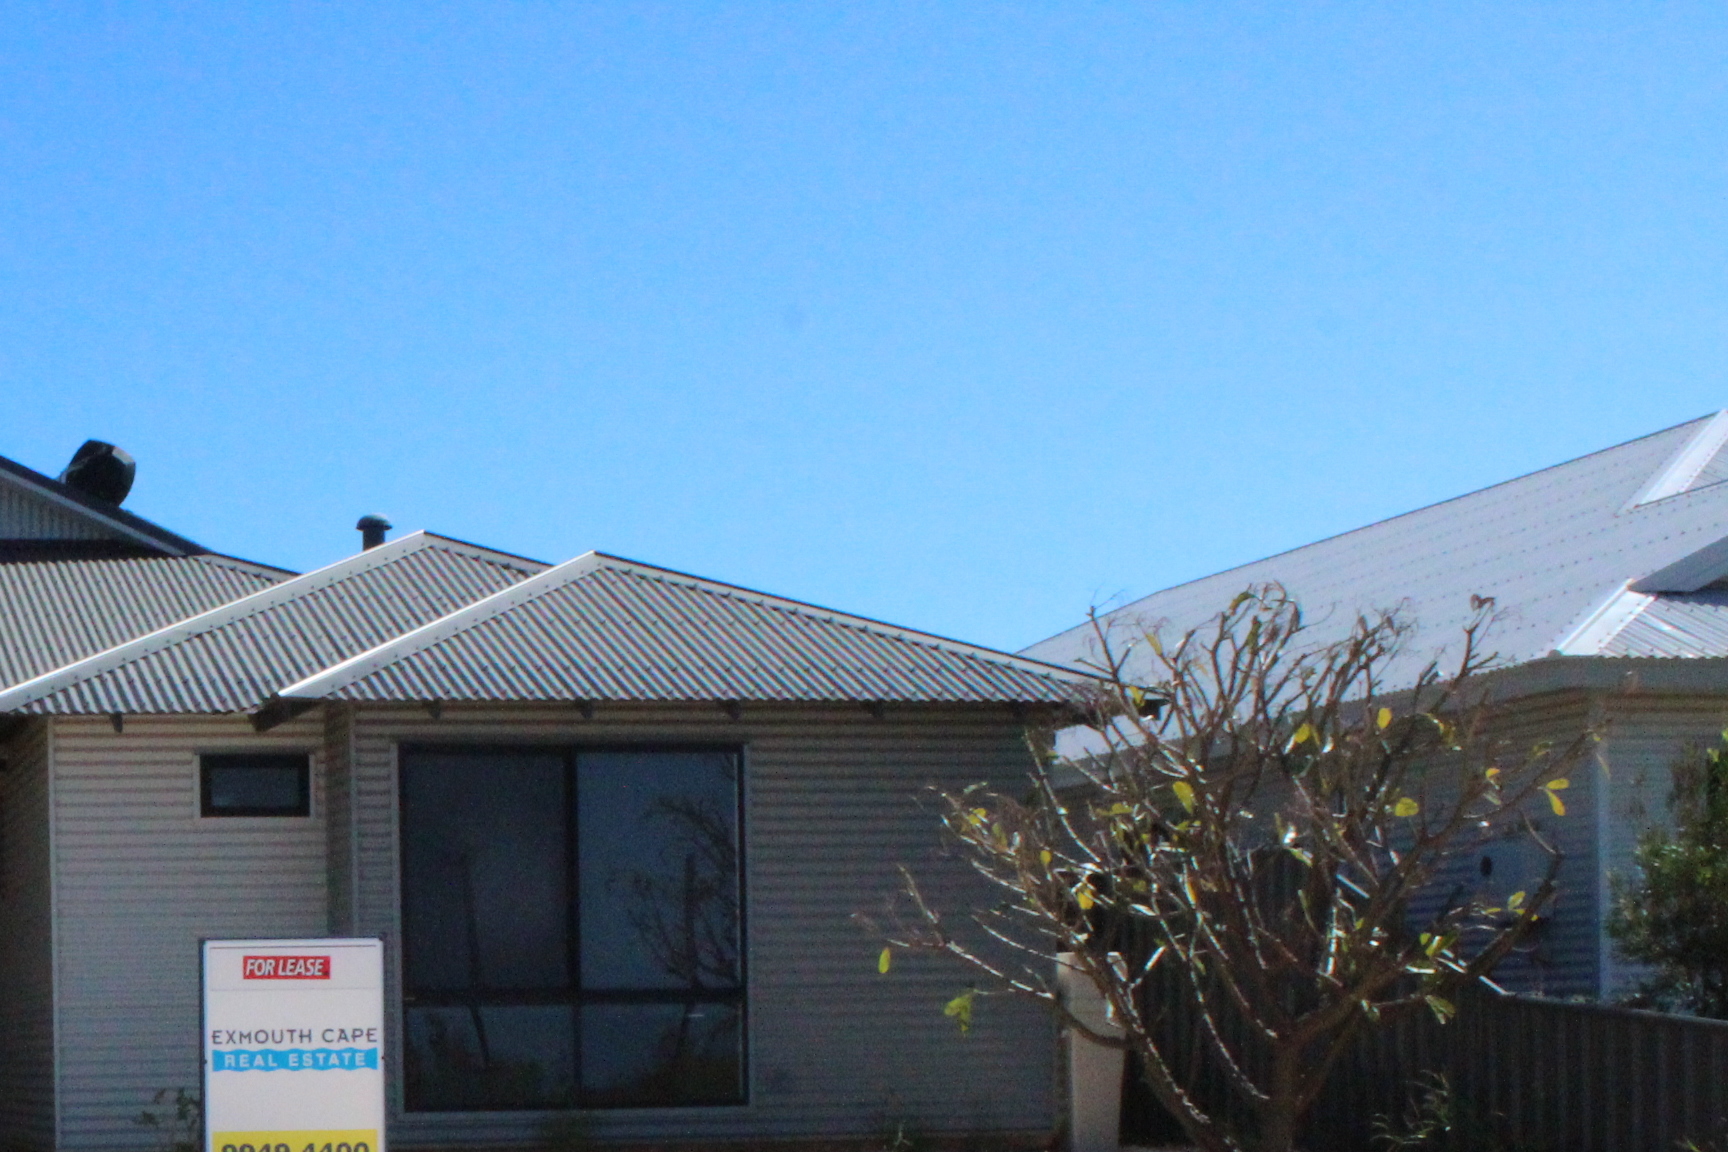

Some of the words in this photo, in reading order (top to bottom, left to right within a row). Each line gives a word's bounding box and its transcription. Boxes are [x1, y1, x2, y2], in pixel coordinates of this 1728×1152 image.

[246, 959, 275, 976] FOR
[278, 958, 323, 976] LEASE
[212, 1029, 312, 1045] EXMOUTH
[322, 1028, 378, 1043] CAPE
[225, 1054, 278, 1067] REAL
[288, 1053, 366, 1066] ESTATE
